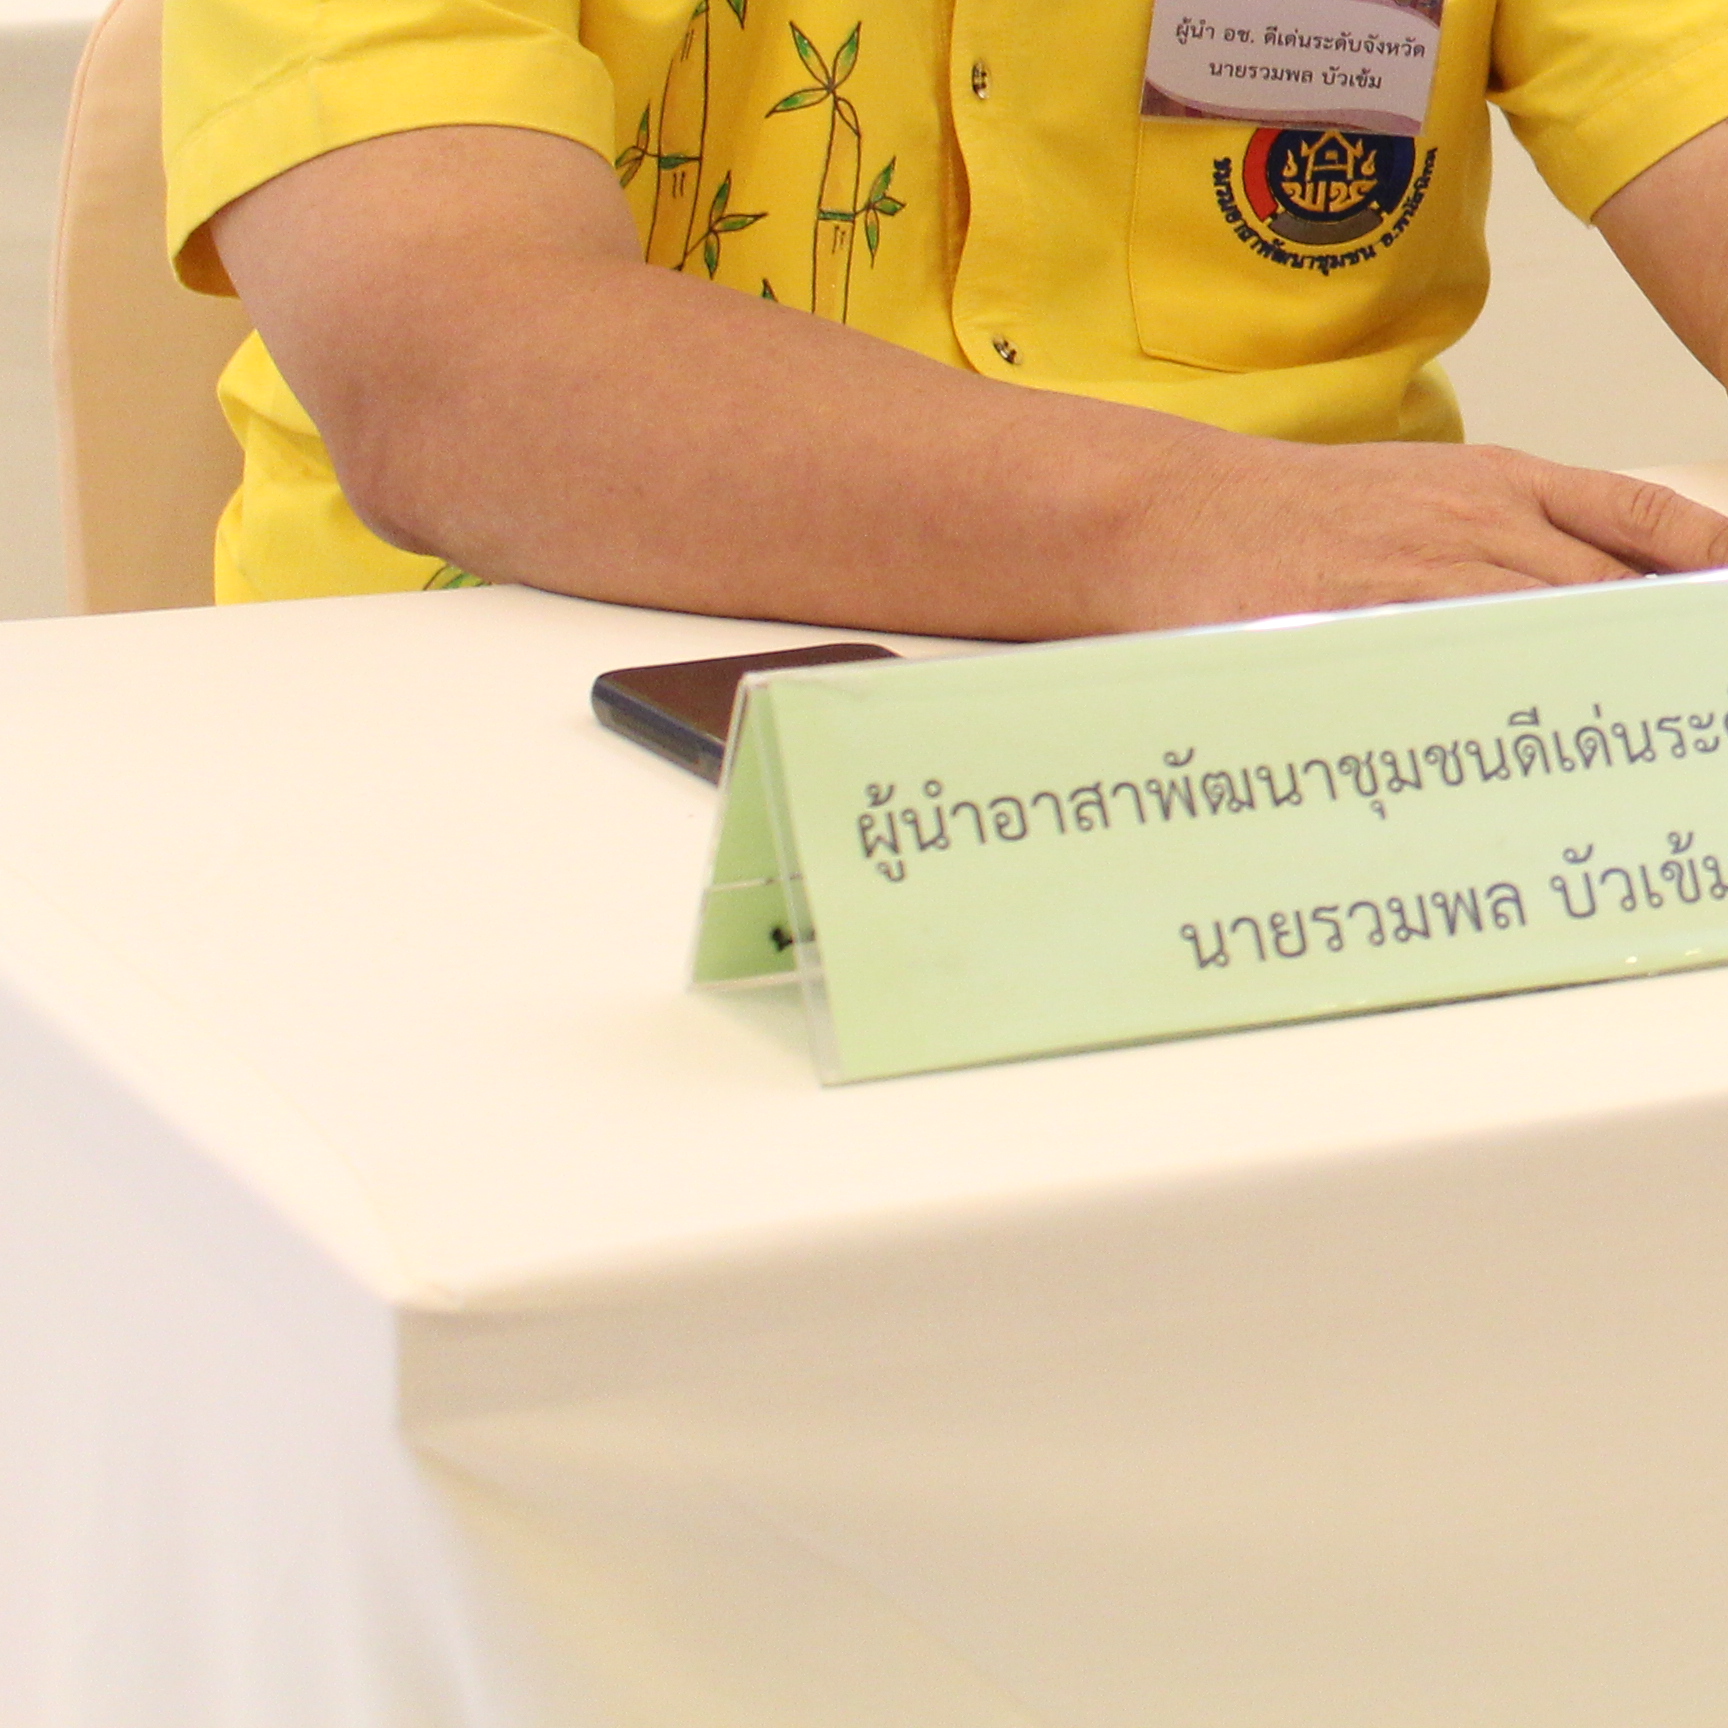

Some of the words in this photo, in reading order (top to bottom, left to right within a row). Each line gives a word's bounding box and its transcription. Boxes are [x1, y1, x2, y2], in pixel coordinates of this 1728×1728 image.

[1174, 17, 1215, 47] ผู้นำ
[1224, 25, 1254, 44] อช.
[1263, 24, 1426, 59] ดีเด่นระดับจังหวัด
[1209, 60, 1313, 84] นายรวมพล
[1321, 65, 1383, 90] บัวเข้ม
[1181, 874, 1527, 972] นายรวมพล
